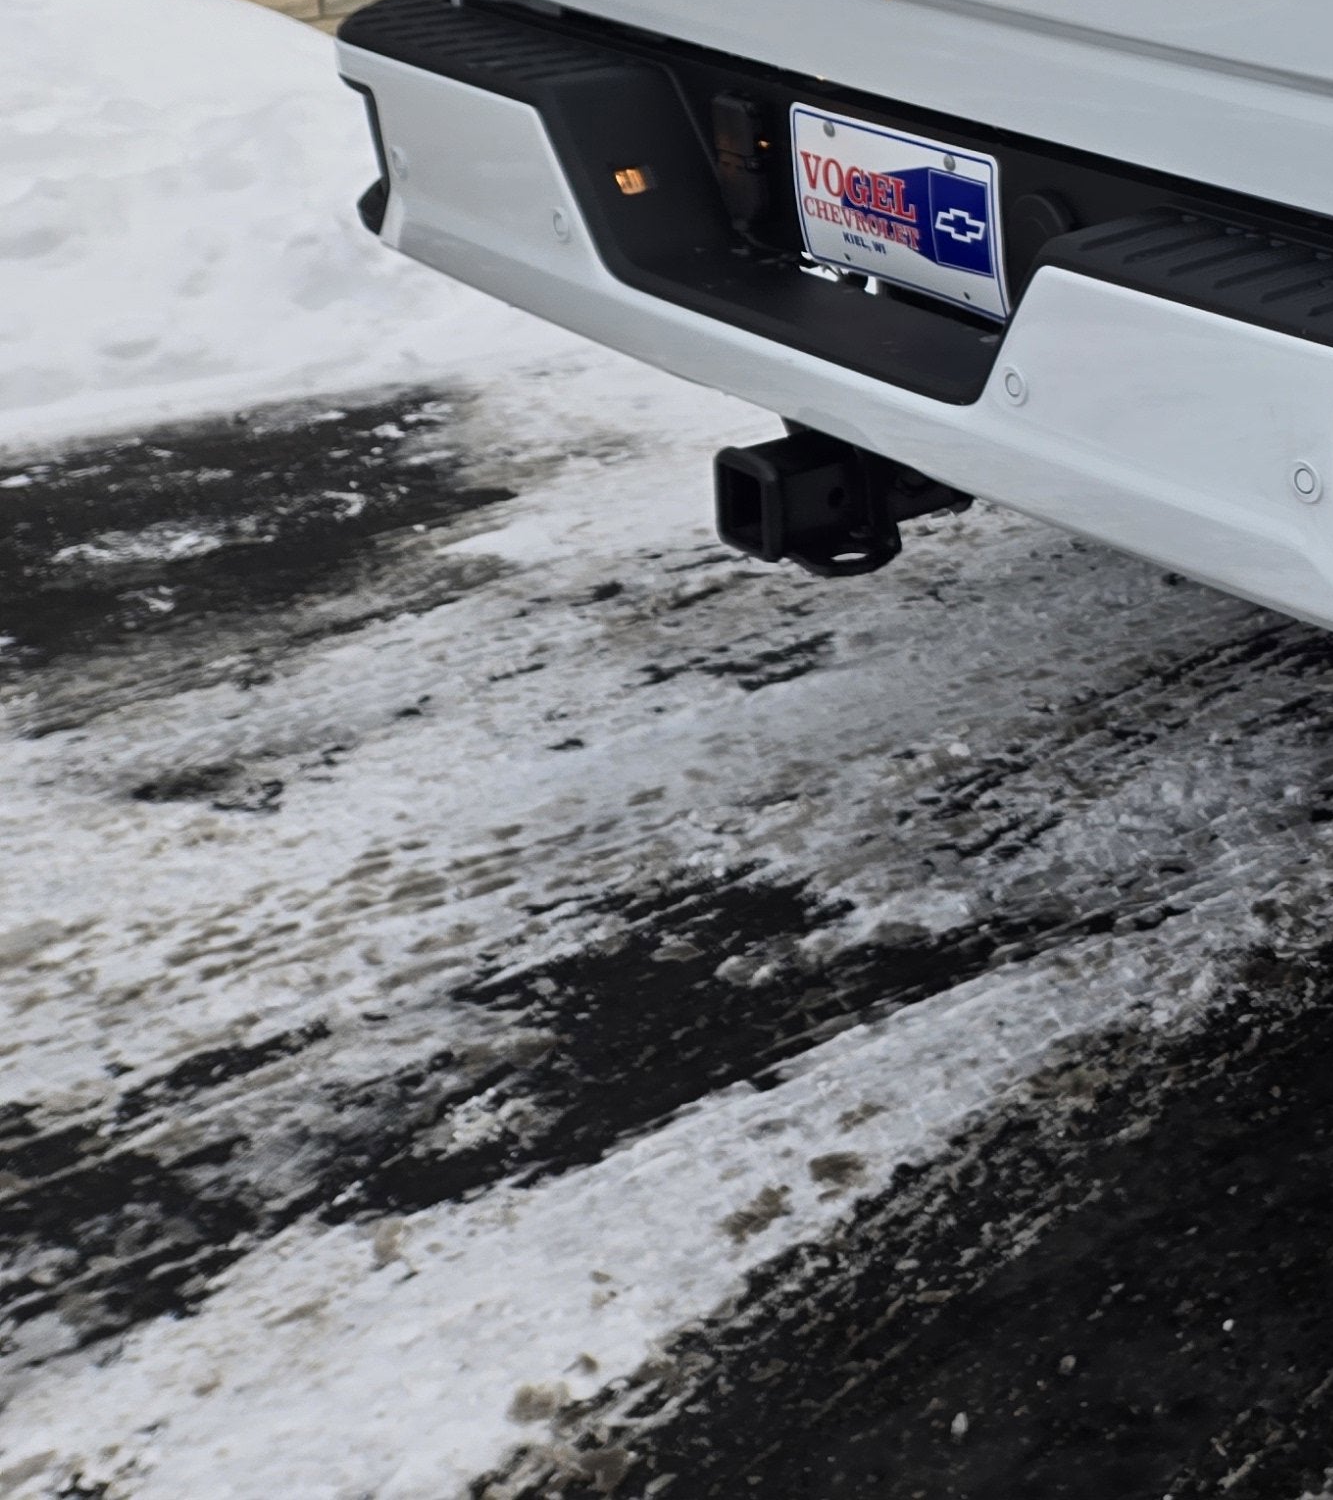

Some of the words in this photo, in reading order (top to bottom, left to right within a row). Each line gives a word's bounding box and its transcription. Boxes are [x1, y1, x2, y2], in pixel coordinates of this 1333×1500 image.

[800, 151, 917, 222] VOGEL
[804, 195, 920, 251] CHEVROLET
[843, 232, 871, 251] KIEL,
[872, 241, 886, 254] WI
